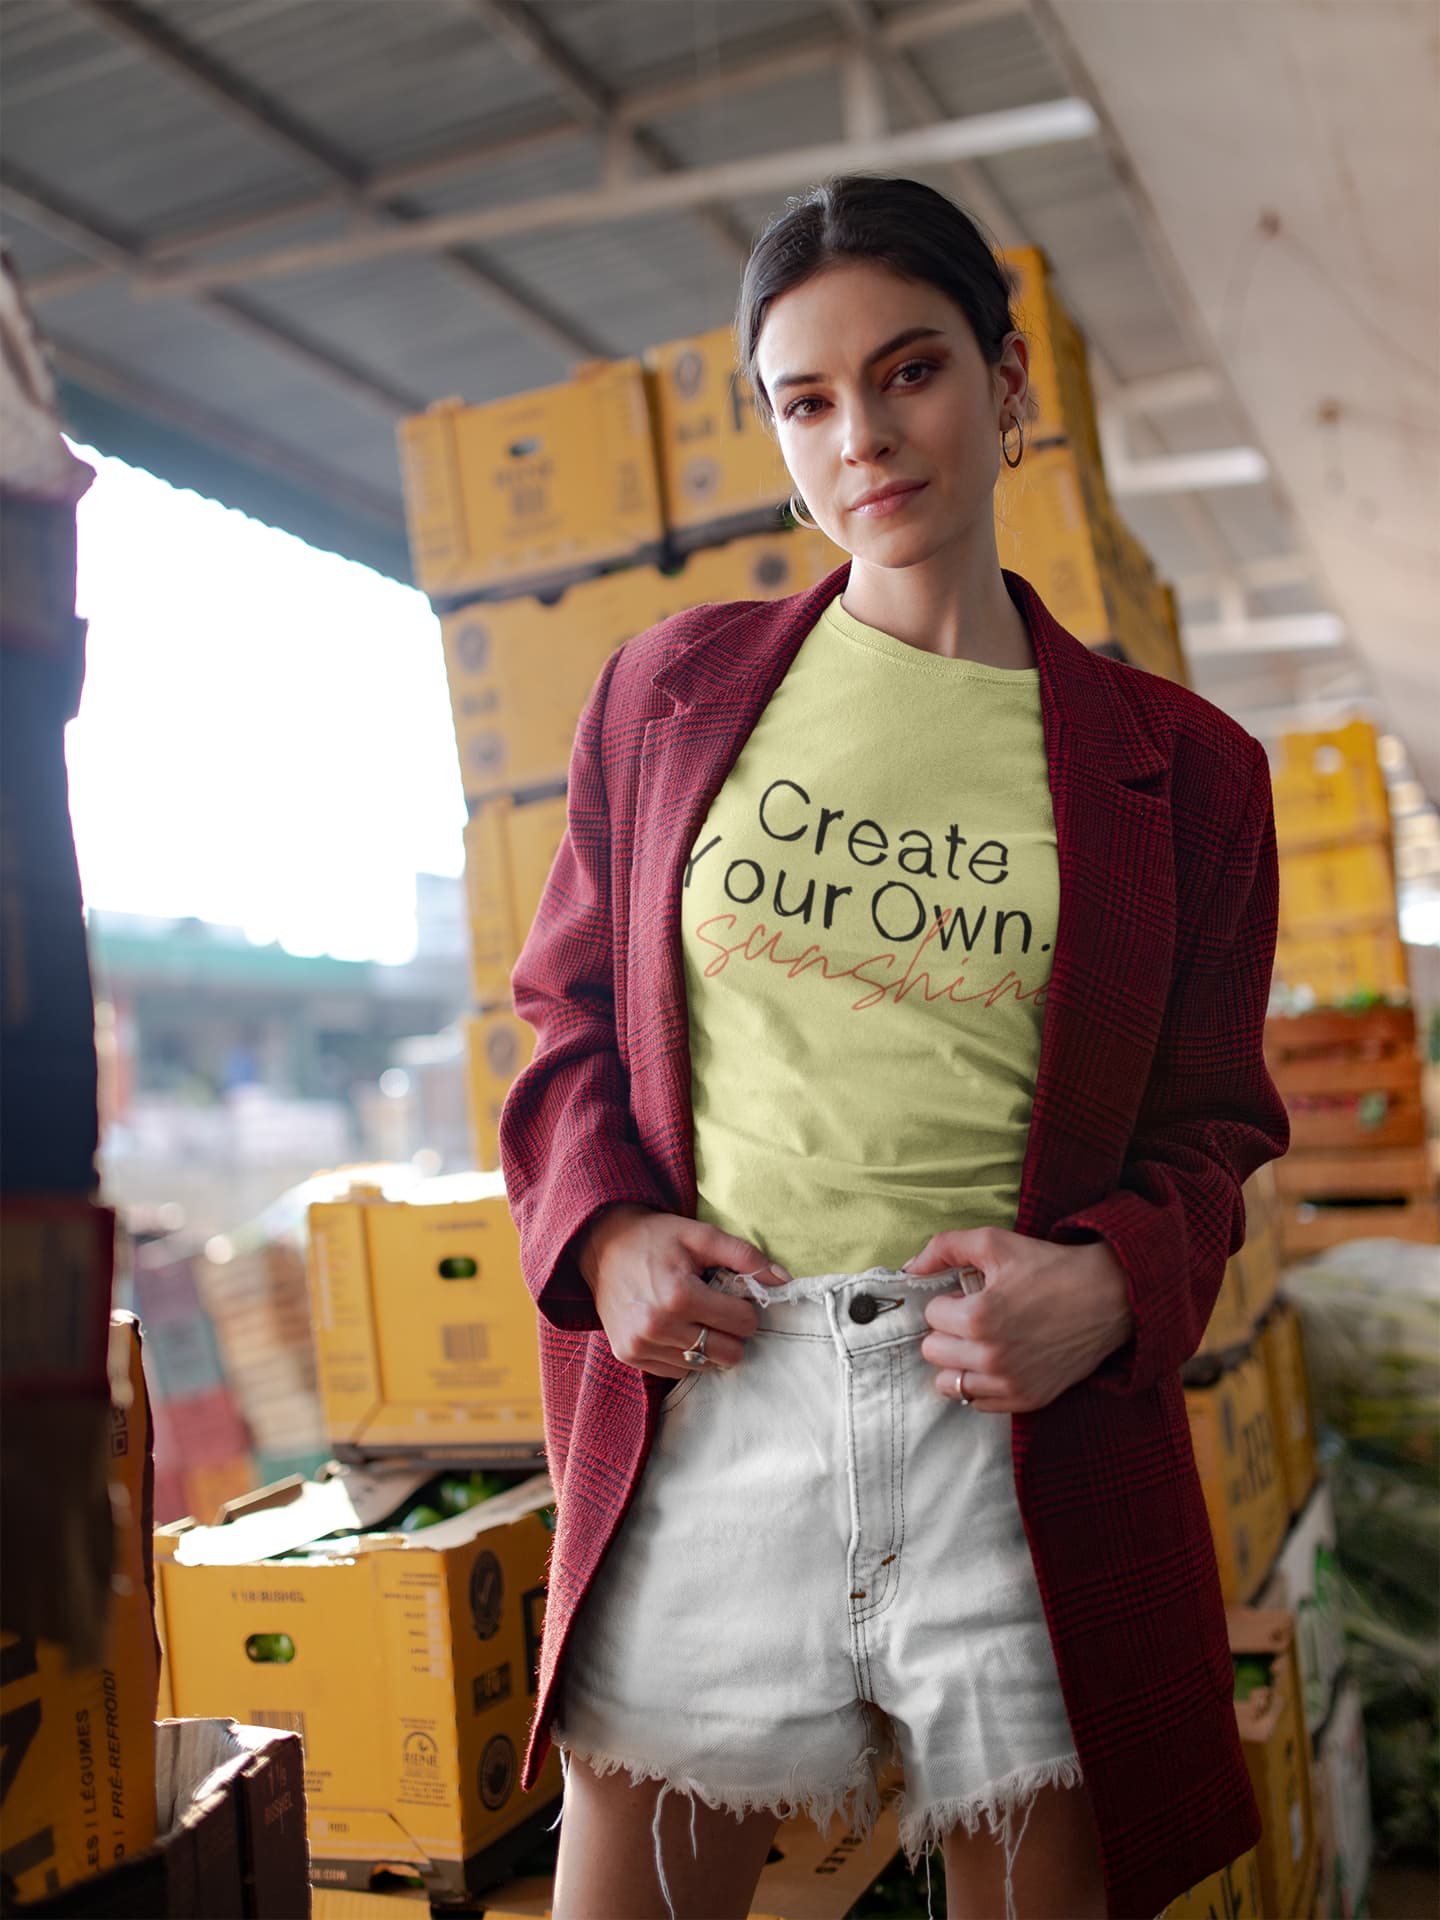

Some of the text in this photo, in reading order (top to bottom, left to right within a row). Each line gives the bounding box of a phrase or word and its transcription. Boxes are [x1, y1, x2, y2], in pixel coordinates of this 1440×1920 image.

[759, 779, 1008, 884] Create
[684, 835, 1050, 954] Your Own.
[76, 1708, 98, 1815] LÉGUMES
[103, 1669, 125, 1820] PRÉ-REFROIDI
